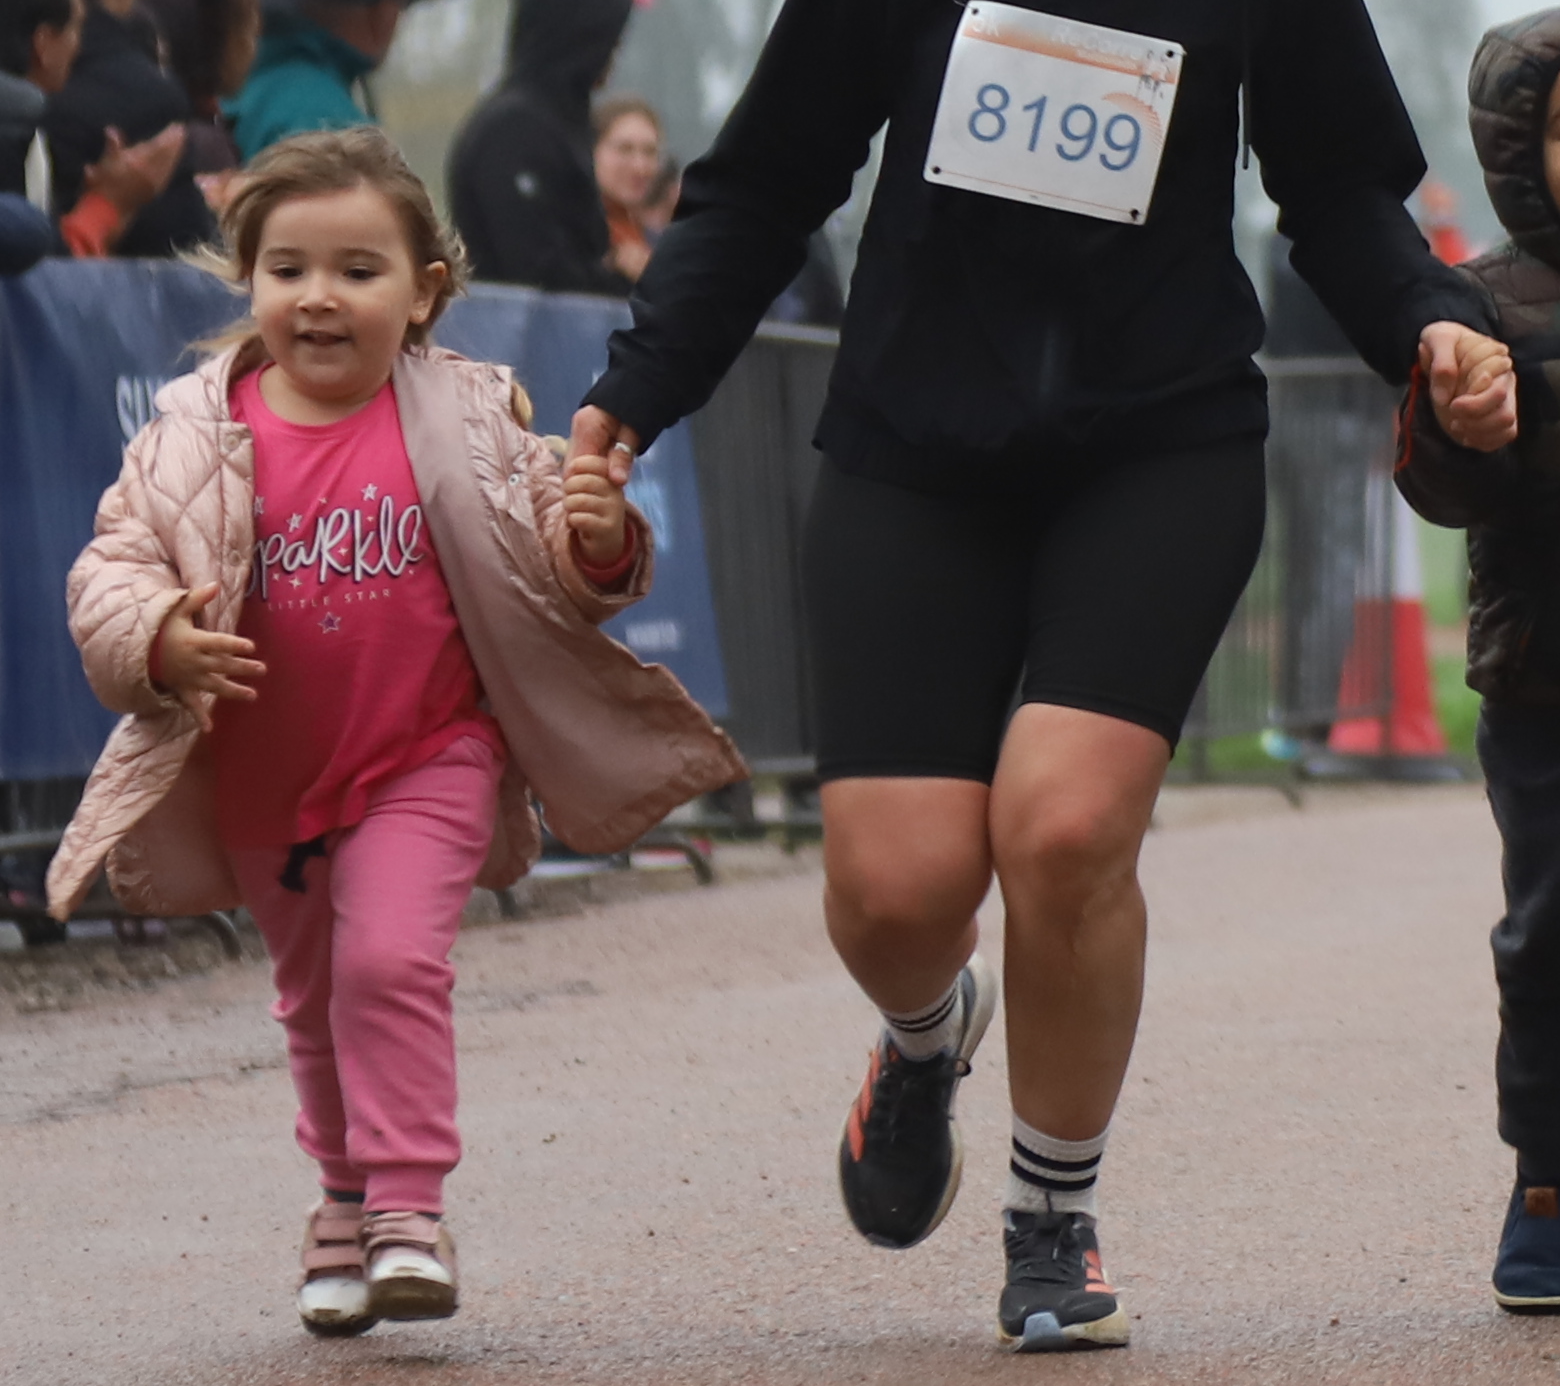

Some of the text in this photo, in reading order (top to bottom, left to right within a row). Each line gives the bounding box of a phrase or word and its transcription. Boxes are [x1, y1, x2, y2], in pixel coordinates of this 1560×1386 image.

[967, 83, 1142, 172] 8199
[268, 589, 391, 611] LITTLE STAR
